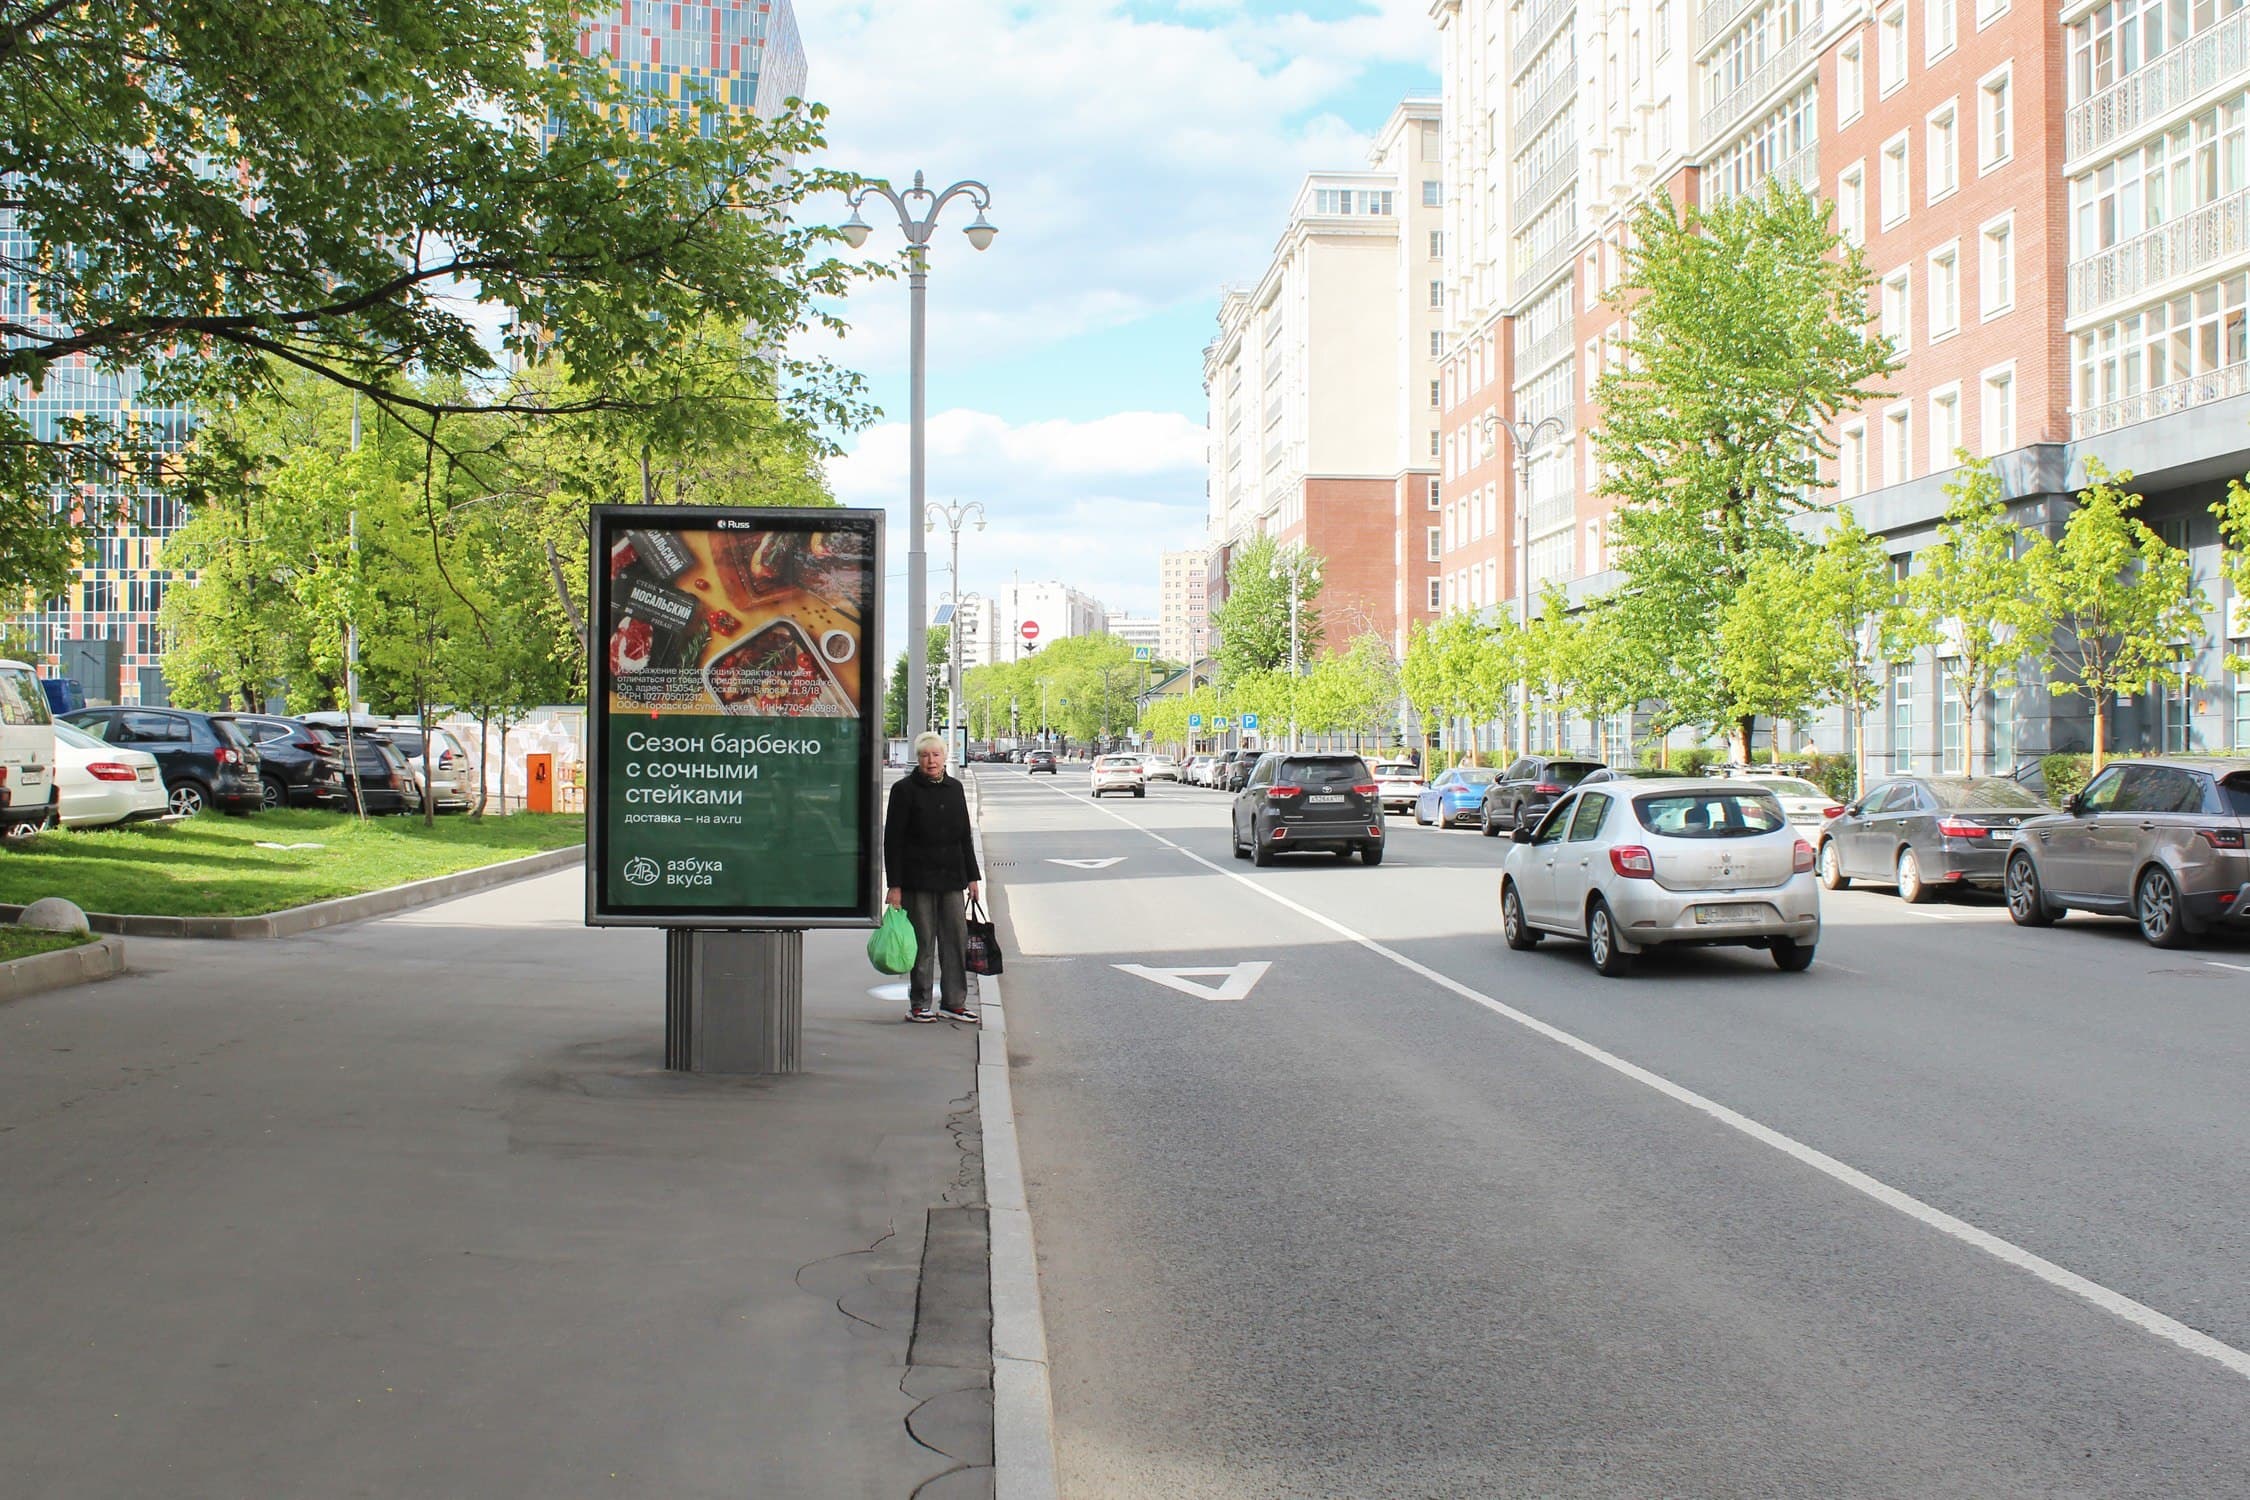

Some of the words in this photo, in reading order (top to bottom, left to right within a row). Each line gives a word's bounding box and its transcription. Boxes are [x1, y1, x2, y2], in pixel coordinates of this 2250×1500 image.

[727, 520, 750, 529] Russ
[630, 587, 692, 620] МОСАЛЬСКИЙ
[617, 667, 677, 676] Иражение
[737, 669, 776, 678] характер
[635, 685, 664, 693] адрес:
[617, 692, 641, 701] ОГРН
[617, 701, 639, 709] ООО
[626, 731, 704, 752] Сезон
[710, 732, 821, 758] барбекю
[625, 762, 641, 778] с
[647, 763, 758, 780] сочными
[625, 784, 743, 805] стейками
[624, 814, 681, 824] доставка
[696, 815, 711, 824] на
[713, 815, 742, 824] av.ru
[667, 857, 723, 874] азбука
[666, 874, 713, 888] вкуса
